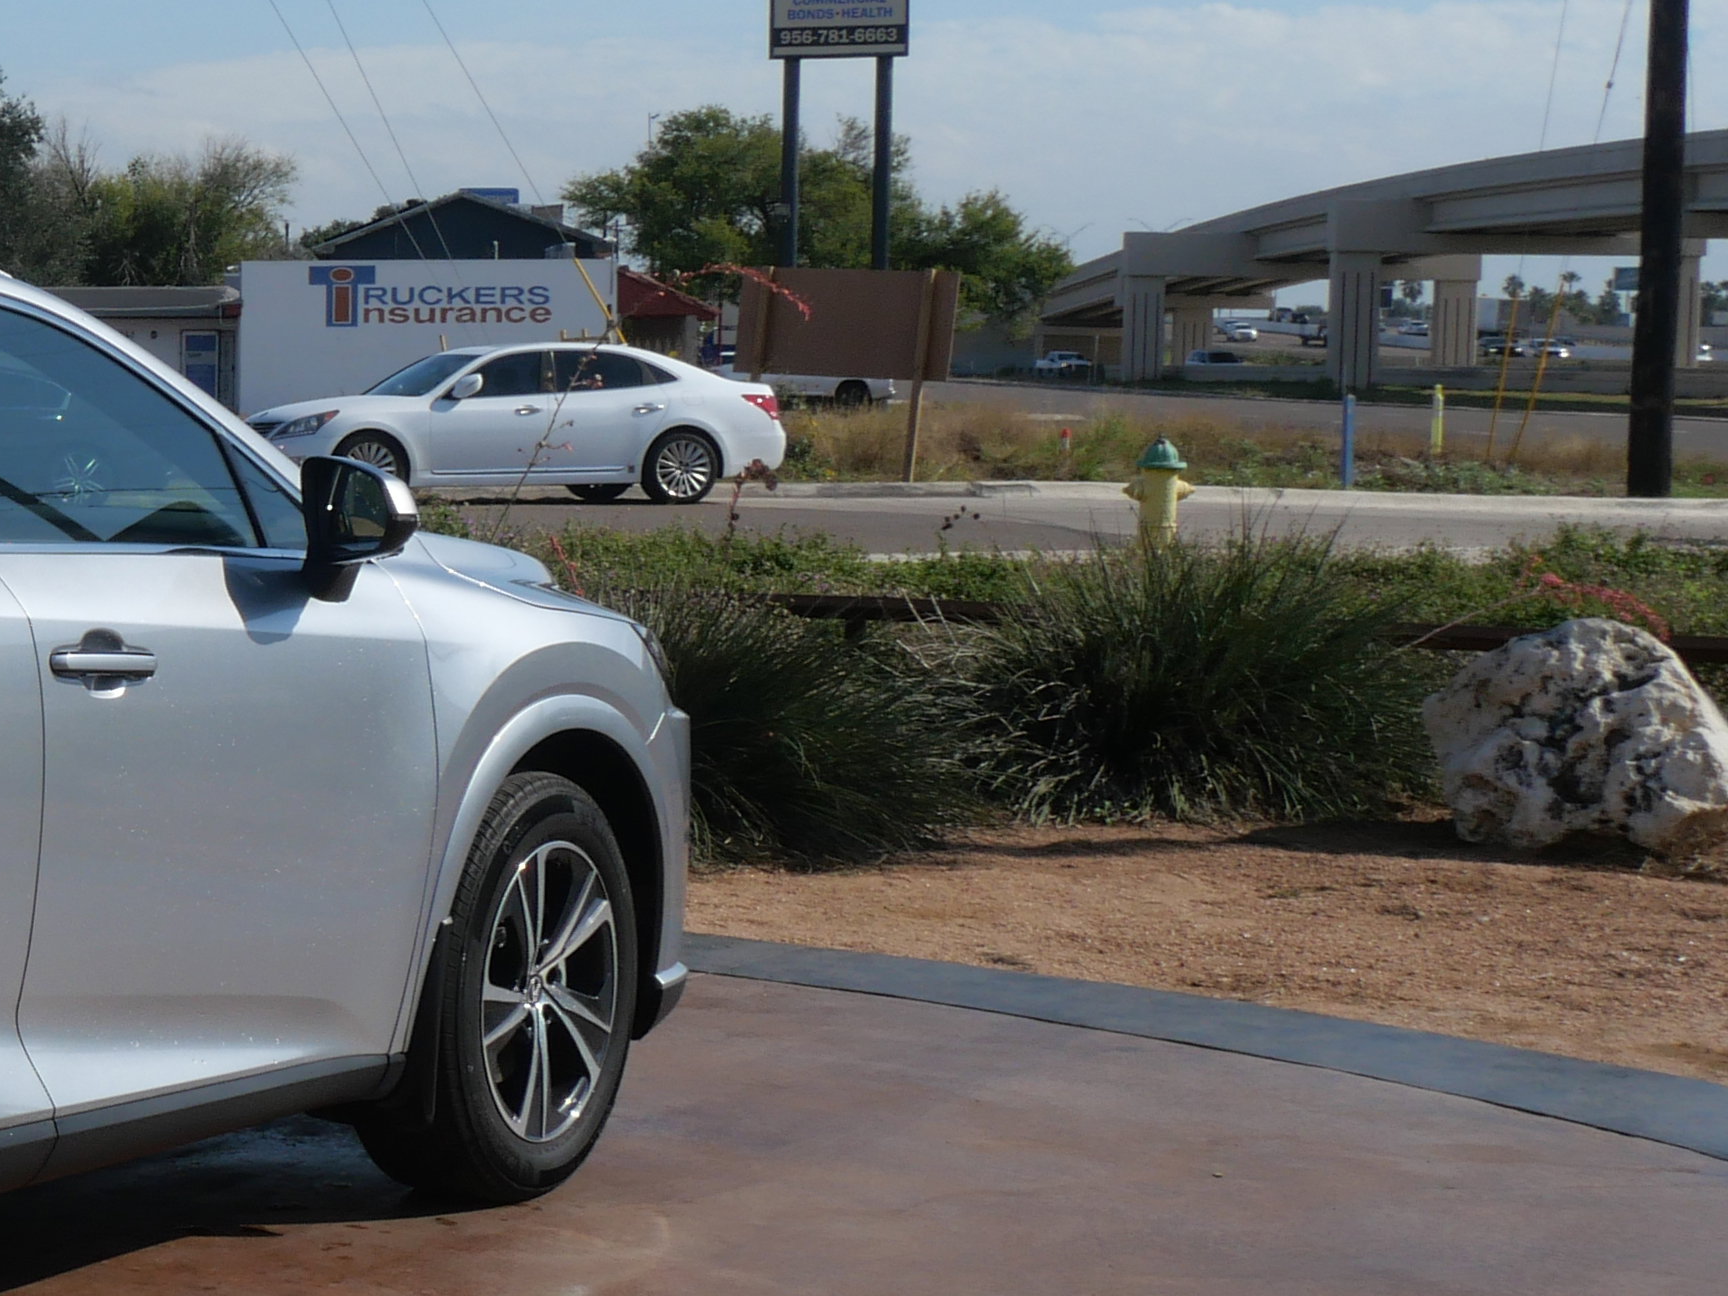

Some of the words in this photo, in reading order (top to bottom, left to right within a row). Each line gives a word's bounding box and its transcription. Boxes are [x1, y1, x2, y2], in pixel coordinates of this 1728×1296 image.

[787, 8, 834, 20] BONDS
[842, 7, 893, 19] HEALTH
[780, 28, 897, 44] 956-781-6663
[308, 265, 550, 328] TRUCKERS
